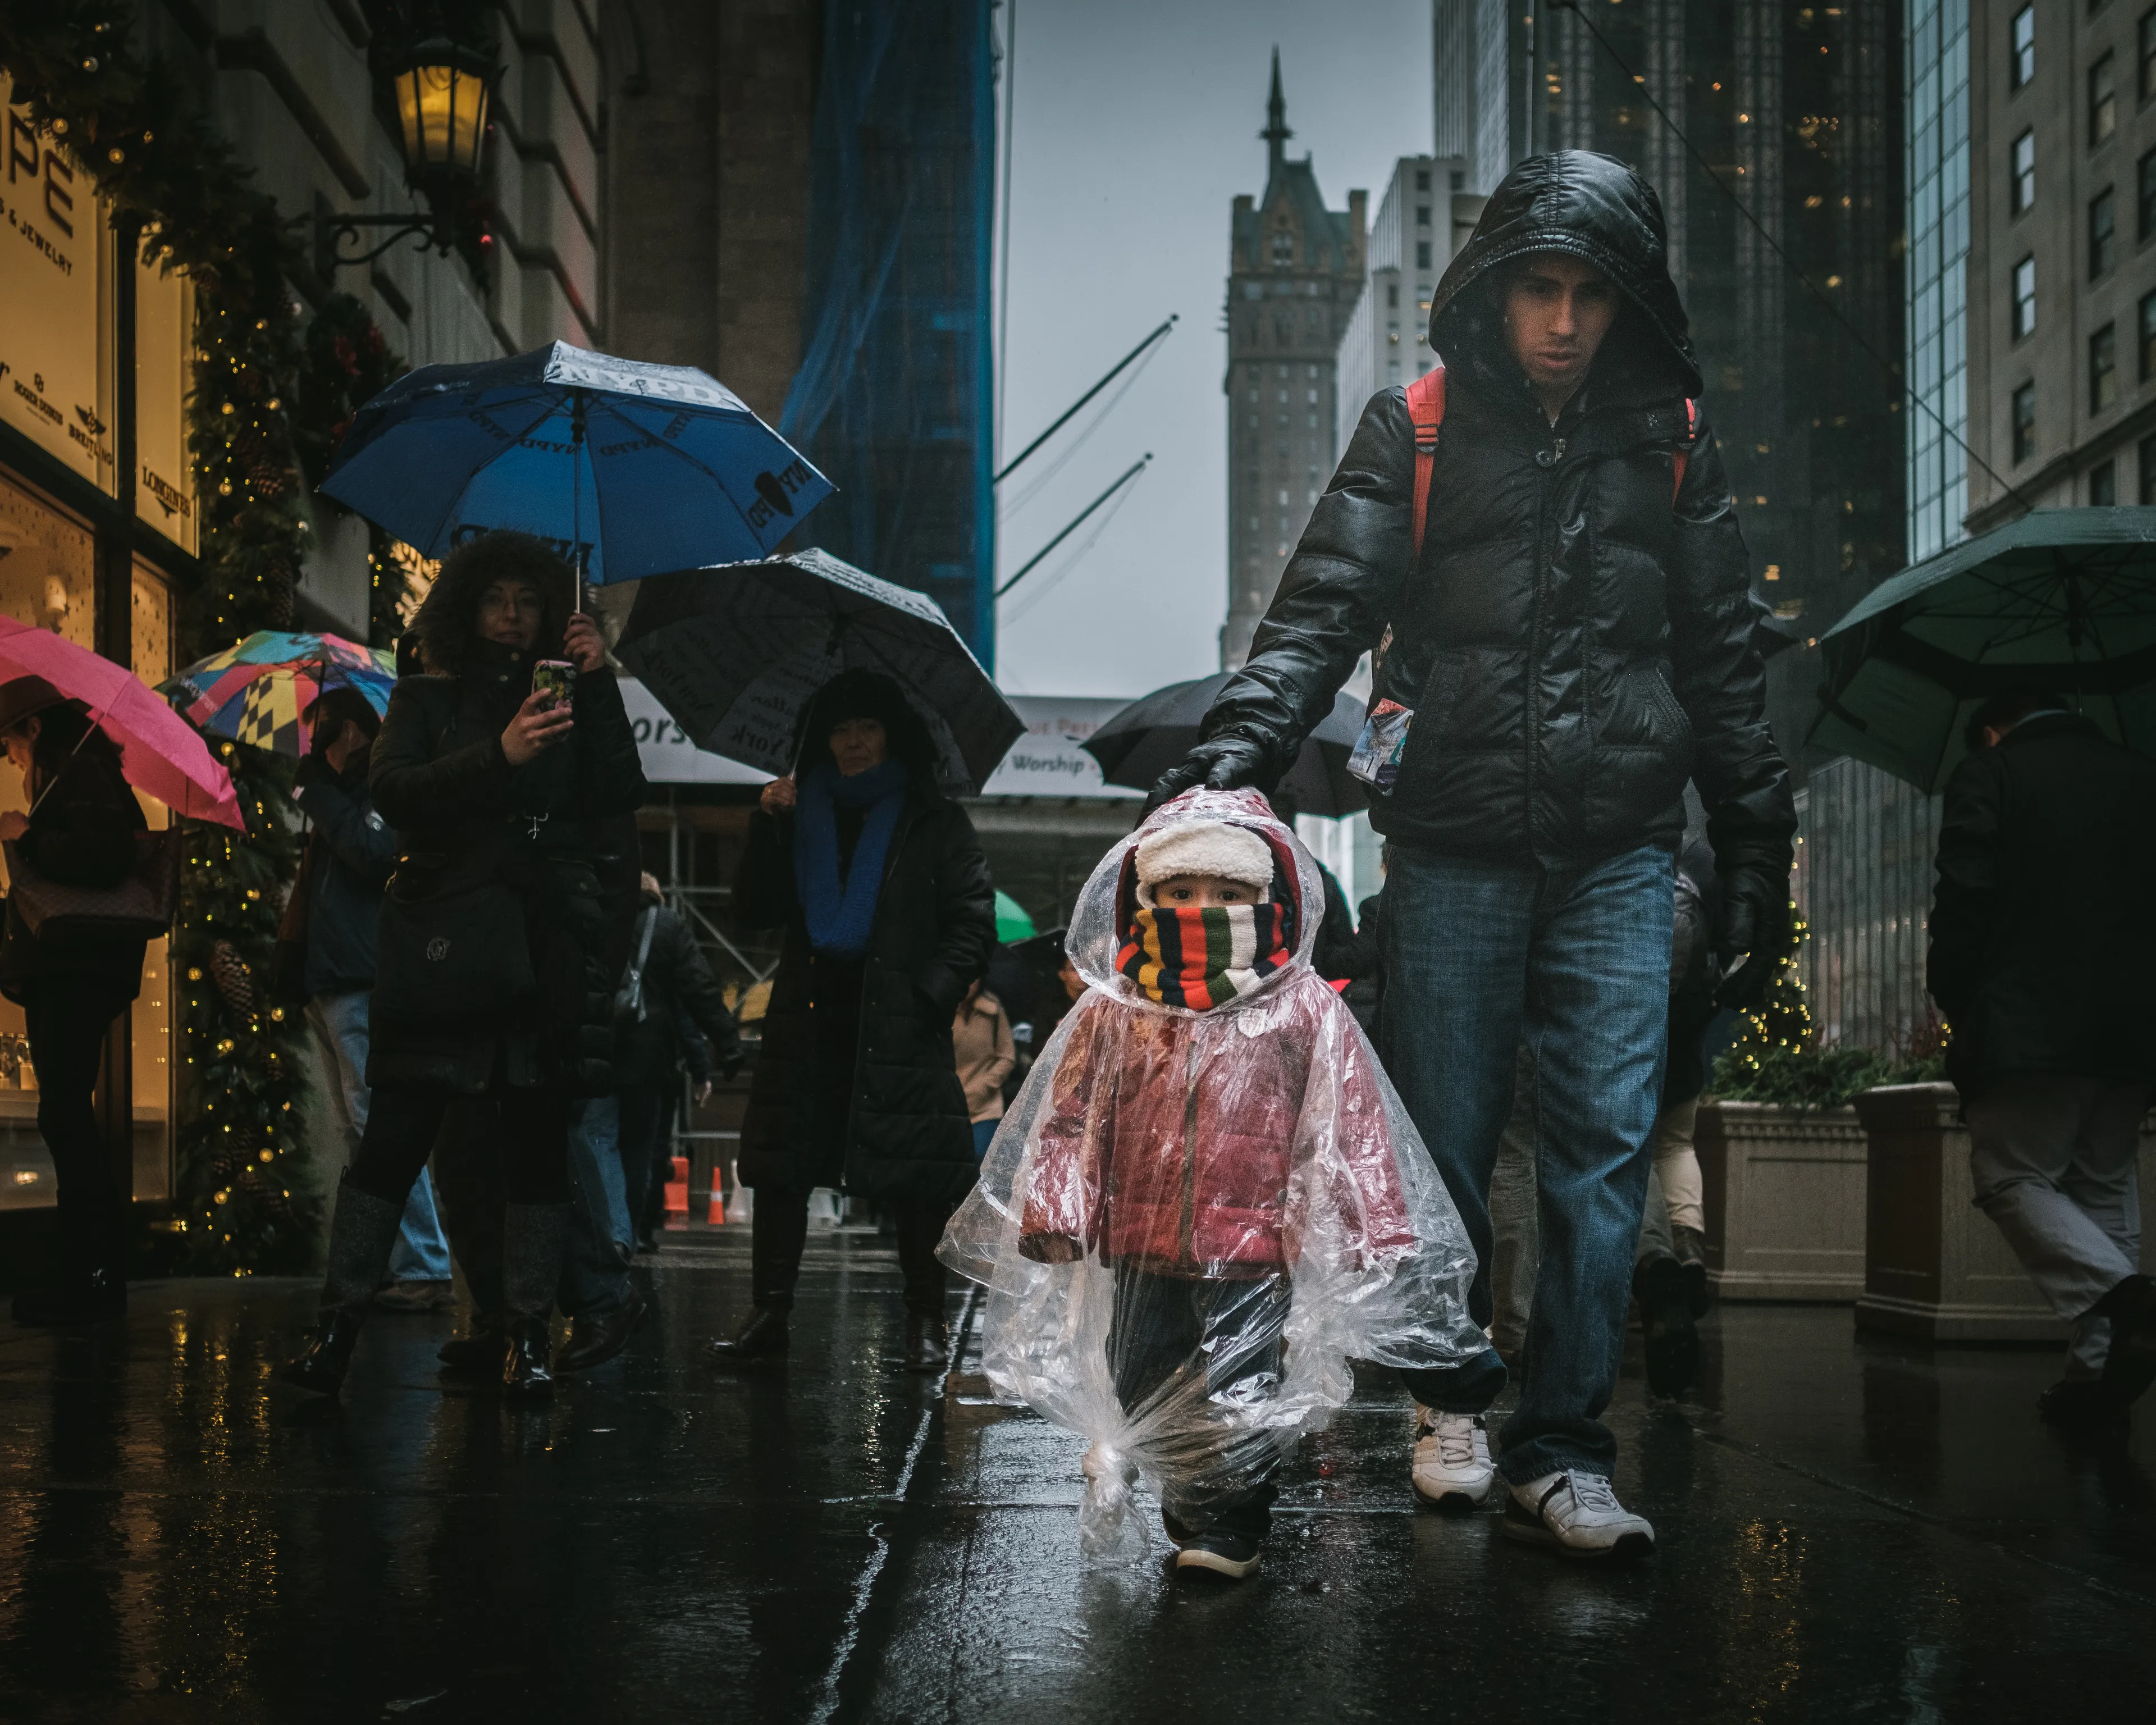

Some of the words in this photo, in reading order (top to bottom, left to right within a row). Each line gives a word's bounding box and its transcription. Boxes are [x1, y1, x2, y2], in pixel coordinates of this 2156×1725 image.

[20, 221, 72, 276] JEWELRY
[68, 422, 112, 466] BREITLING
[143, 466, 191, 518] LONGINES
[1013, 755, 1085, 778] Worship
